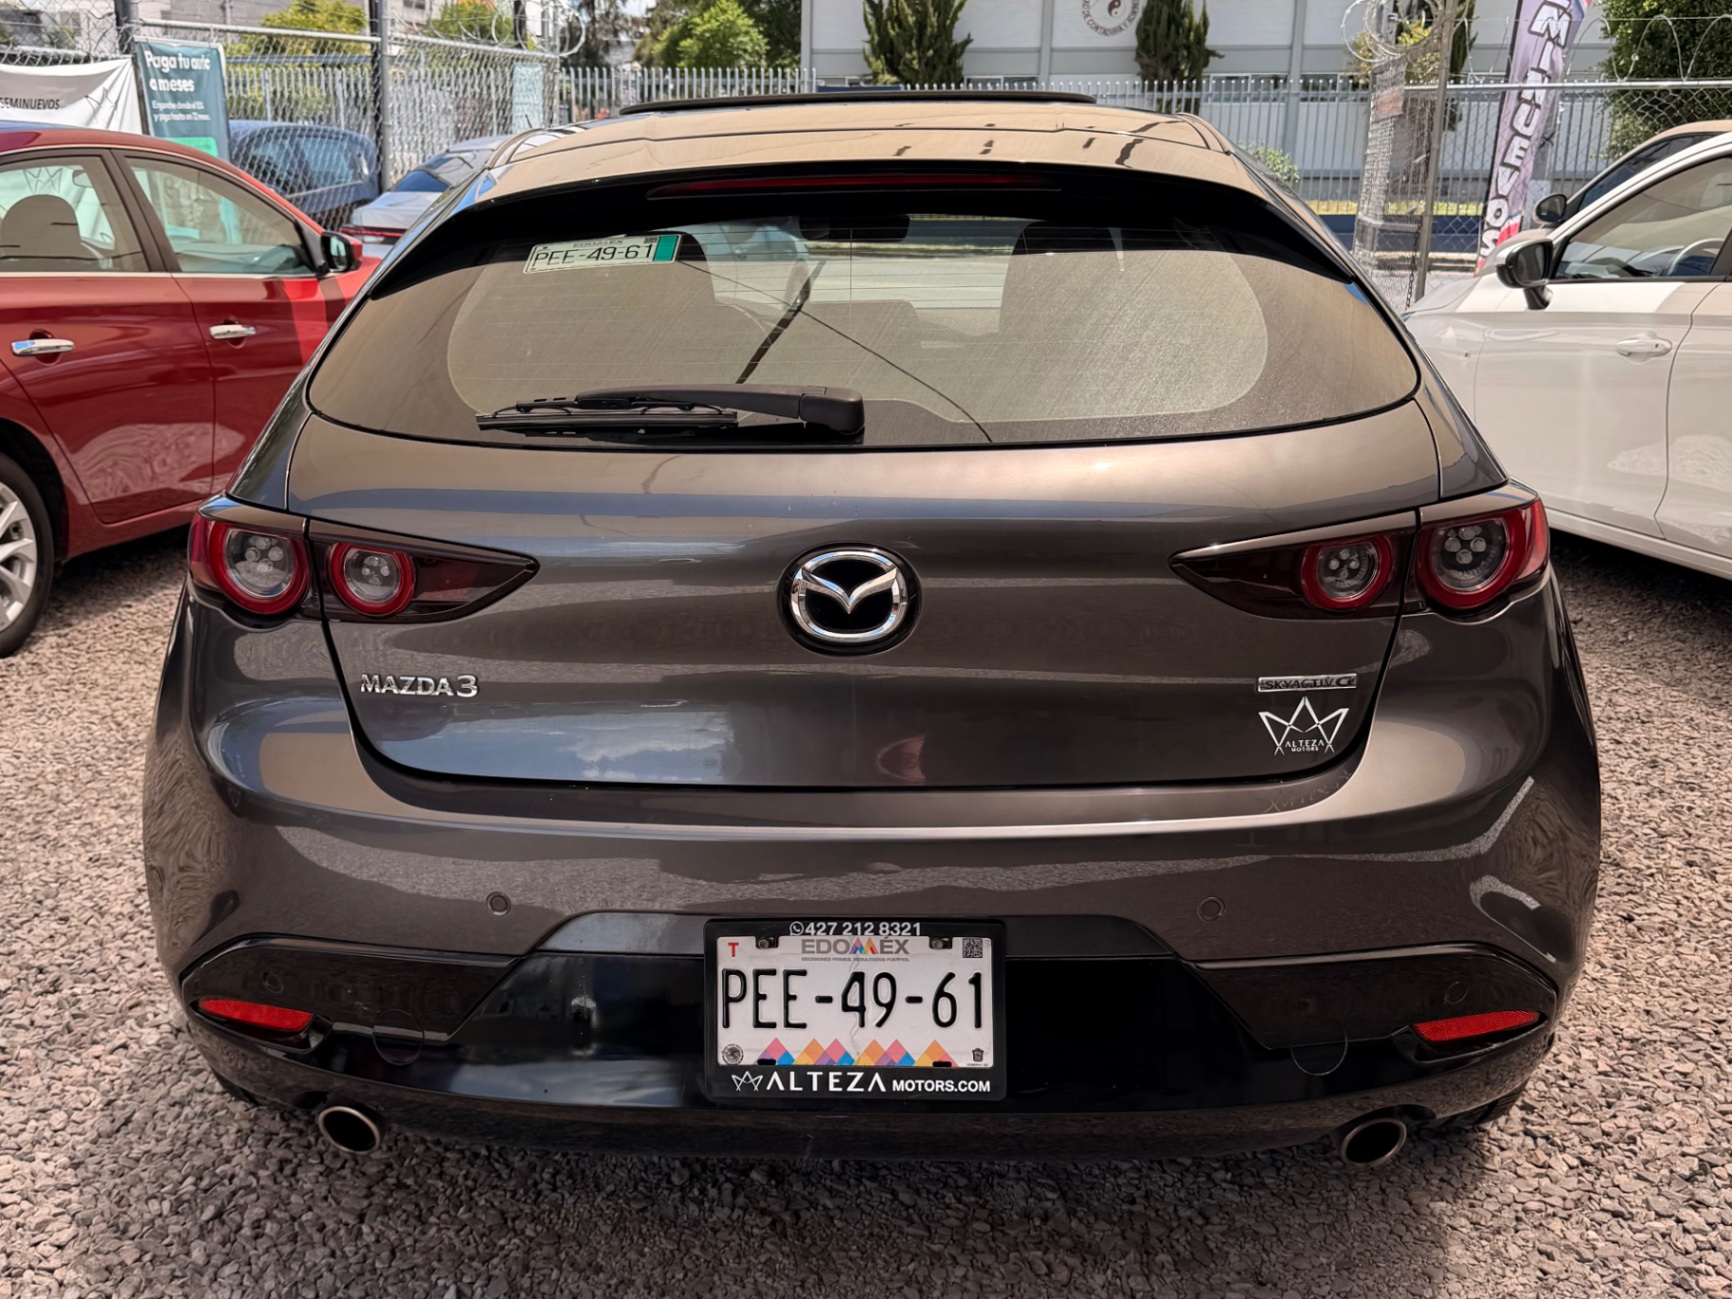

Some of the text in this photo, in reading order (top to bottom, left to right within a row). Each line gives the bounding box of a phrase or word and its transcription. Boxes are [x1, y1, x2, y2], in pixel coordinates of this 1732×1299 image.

[144, 51, 177, 73] Paga
[178, 53, 190, 69] tu
[149, 78, 195, 92] a meses
[0, 97, 60, 110] SEMINUEVOS
[532, 244, 653, 267] PEE-49-61
[1265, 678, 1334, 690] SKYACTIV
[1285, 739, 1325, 748] ALTEZA
[805, 922, 921, 936] 427 212 8321
[728, 942, 739, 957] T
[721, 968, 983, 1029] PEE-49-61
[766, 1071, 991, 1092] ALTEZA MOTORS.COM
